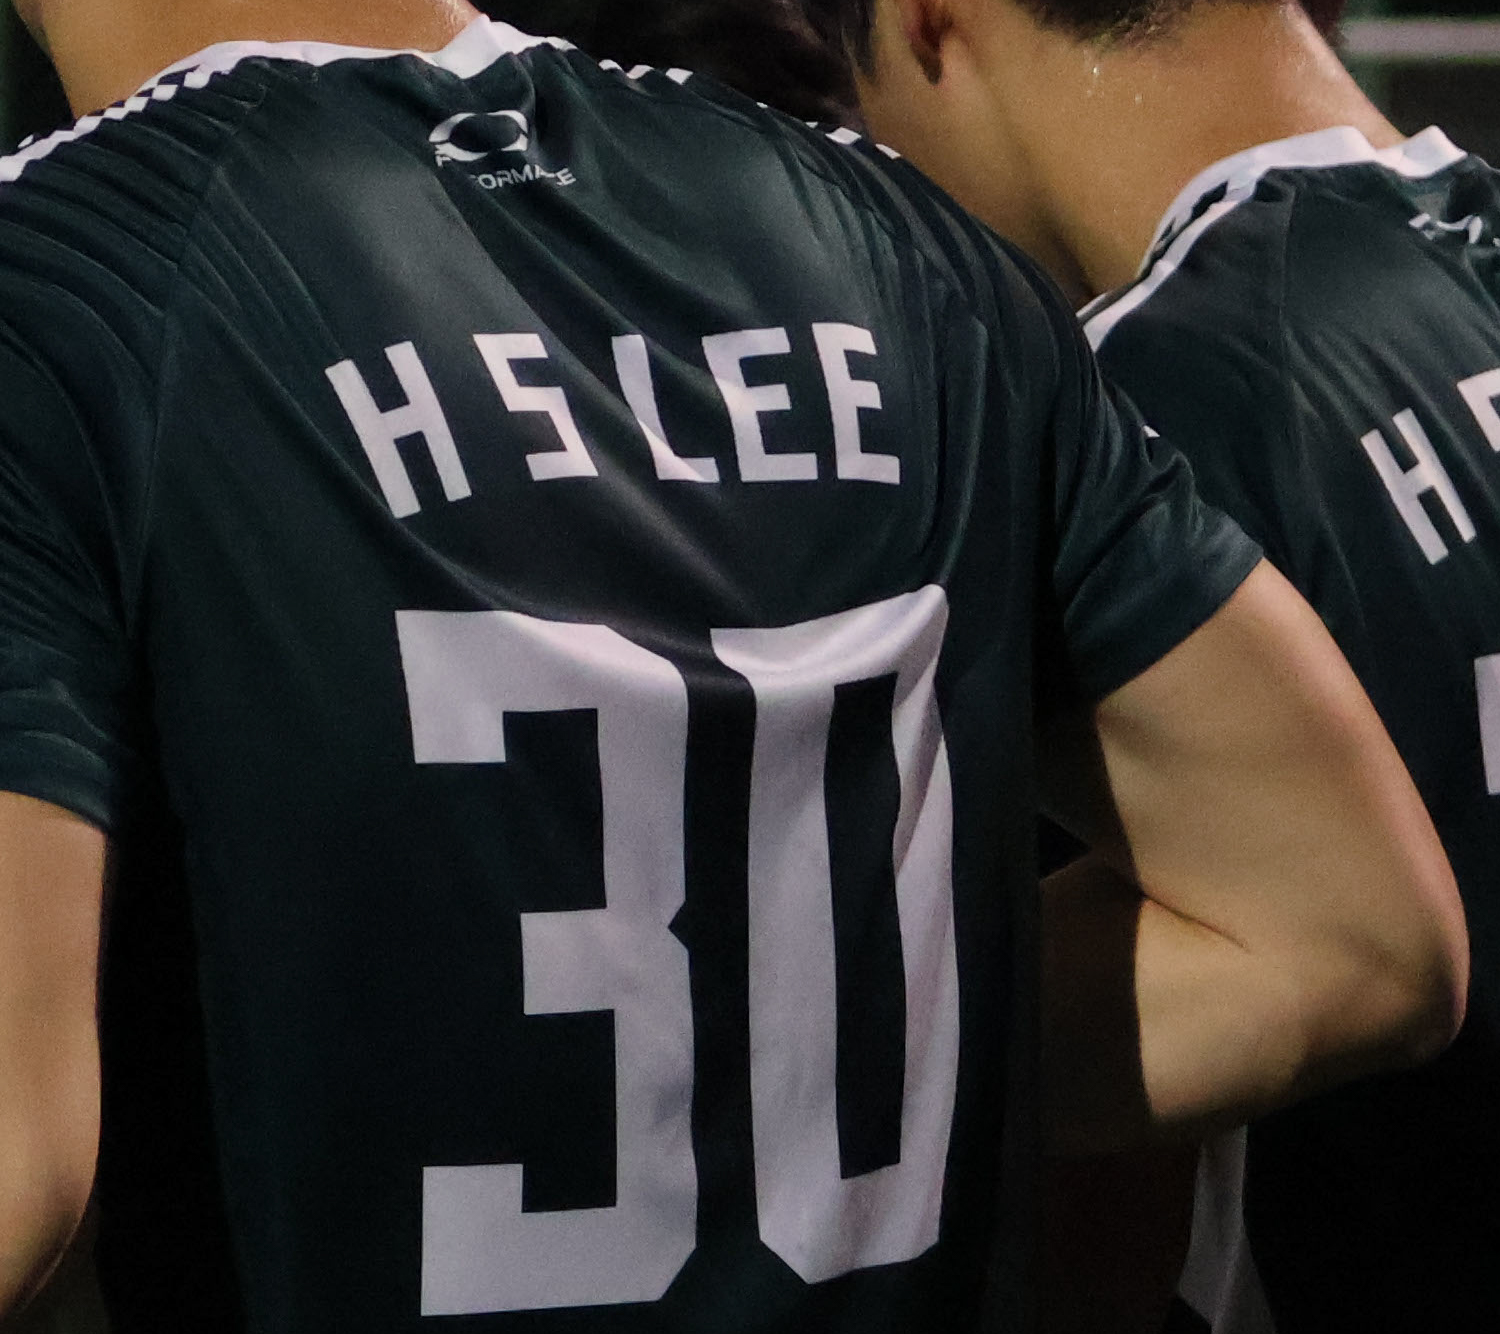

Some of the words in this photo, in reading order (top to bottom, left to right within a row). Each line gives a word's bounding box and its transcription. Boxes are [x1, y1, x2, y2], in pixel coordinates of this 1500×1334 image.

[325, 340, 472, 519] H
[473, 333, 598, 481] S
[611, 322, 901, 485] LEE
[1360, 408, 1477, 565] H
[394, 583, 961, 1318] 30
